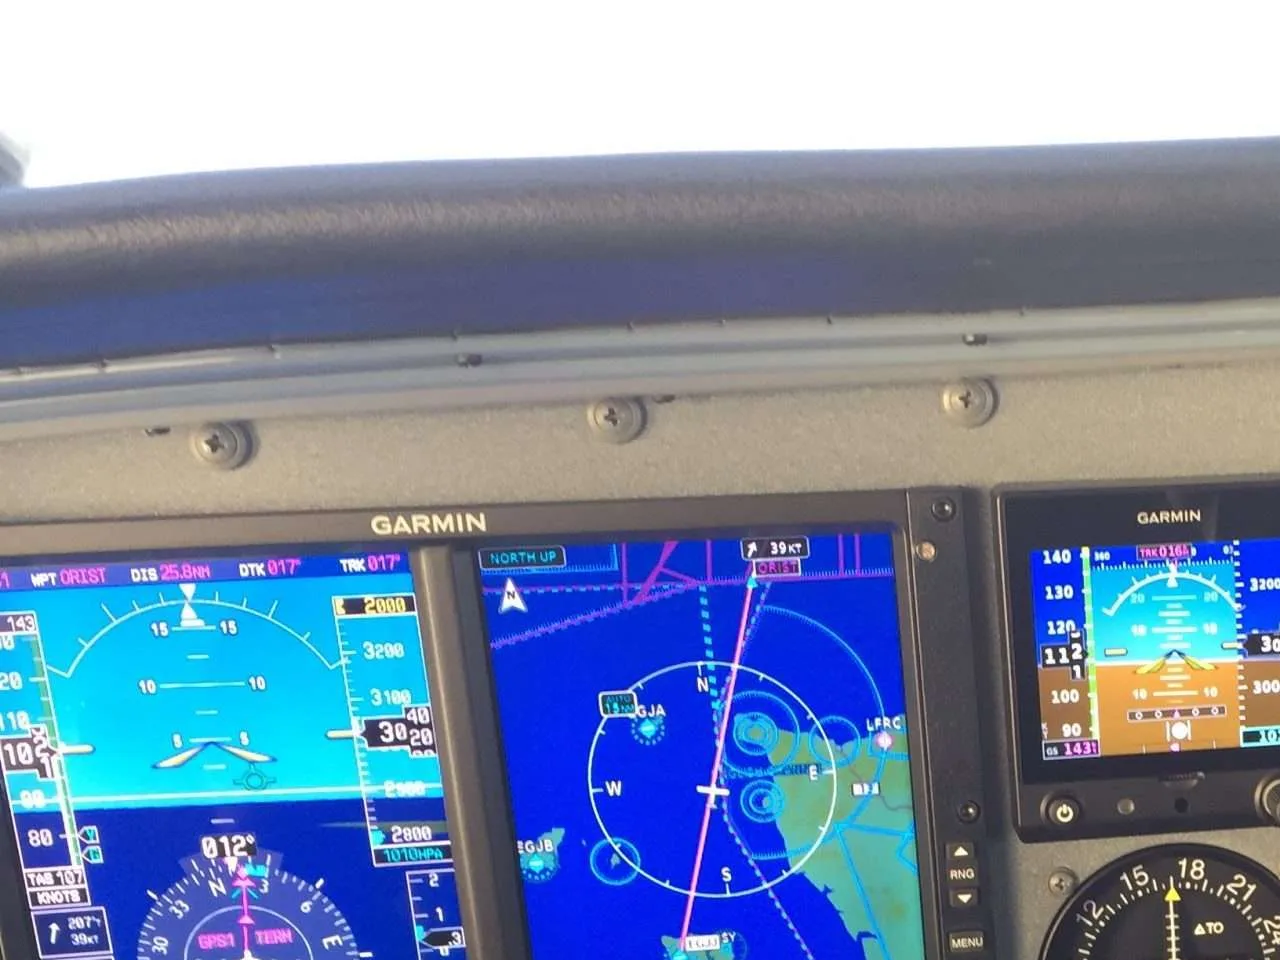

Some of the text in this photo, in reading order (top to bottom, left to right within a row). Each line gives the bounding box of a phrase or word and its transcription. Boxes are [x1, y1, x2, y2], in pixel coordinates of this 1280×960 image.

[371, 512, 487, 535] GARMIN
[1137, 509, 1201, 525] GARMIN
[490, 551, 556, 566] NORTH UP
[1042, 550, 1072, 564] 140
[131, 567, 157, 582] DIS
[758, 561, 798, 575] ORIST
[60, 568, 107, 585] ORIST
[1045, 586, 1074, 600] 130
[1051, 690, 1080, 704] 100
[950, 867, 975, 880] RNG
[1178, 858, 1205, 880] 18
[1119, 864, 1150, 890] 15
[1226, 873, 1257, 902] 21
[951, 936, 984, 949] MENU
